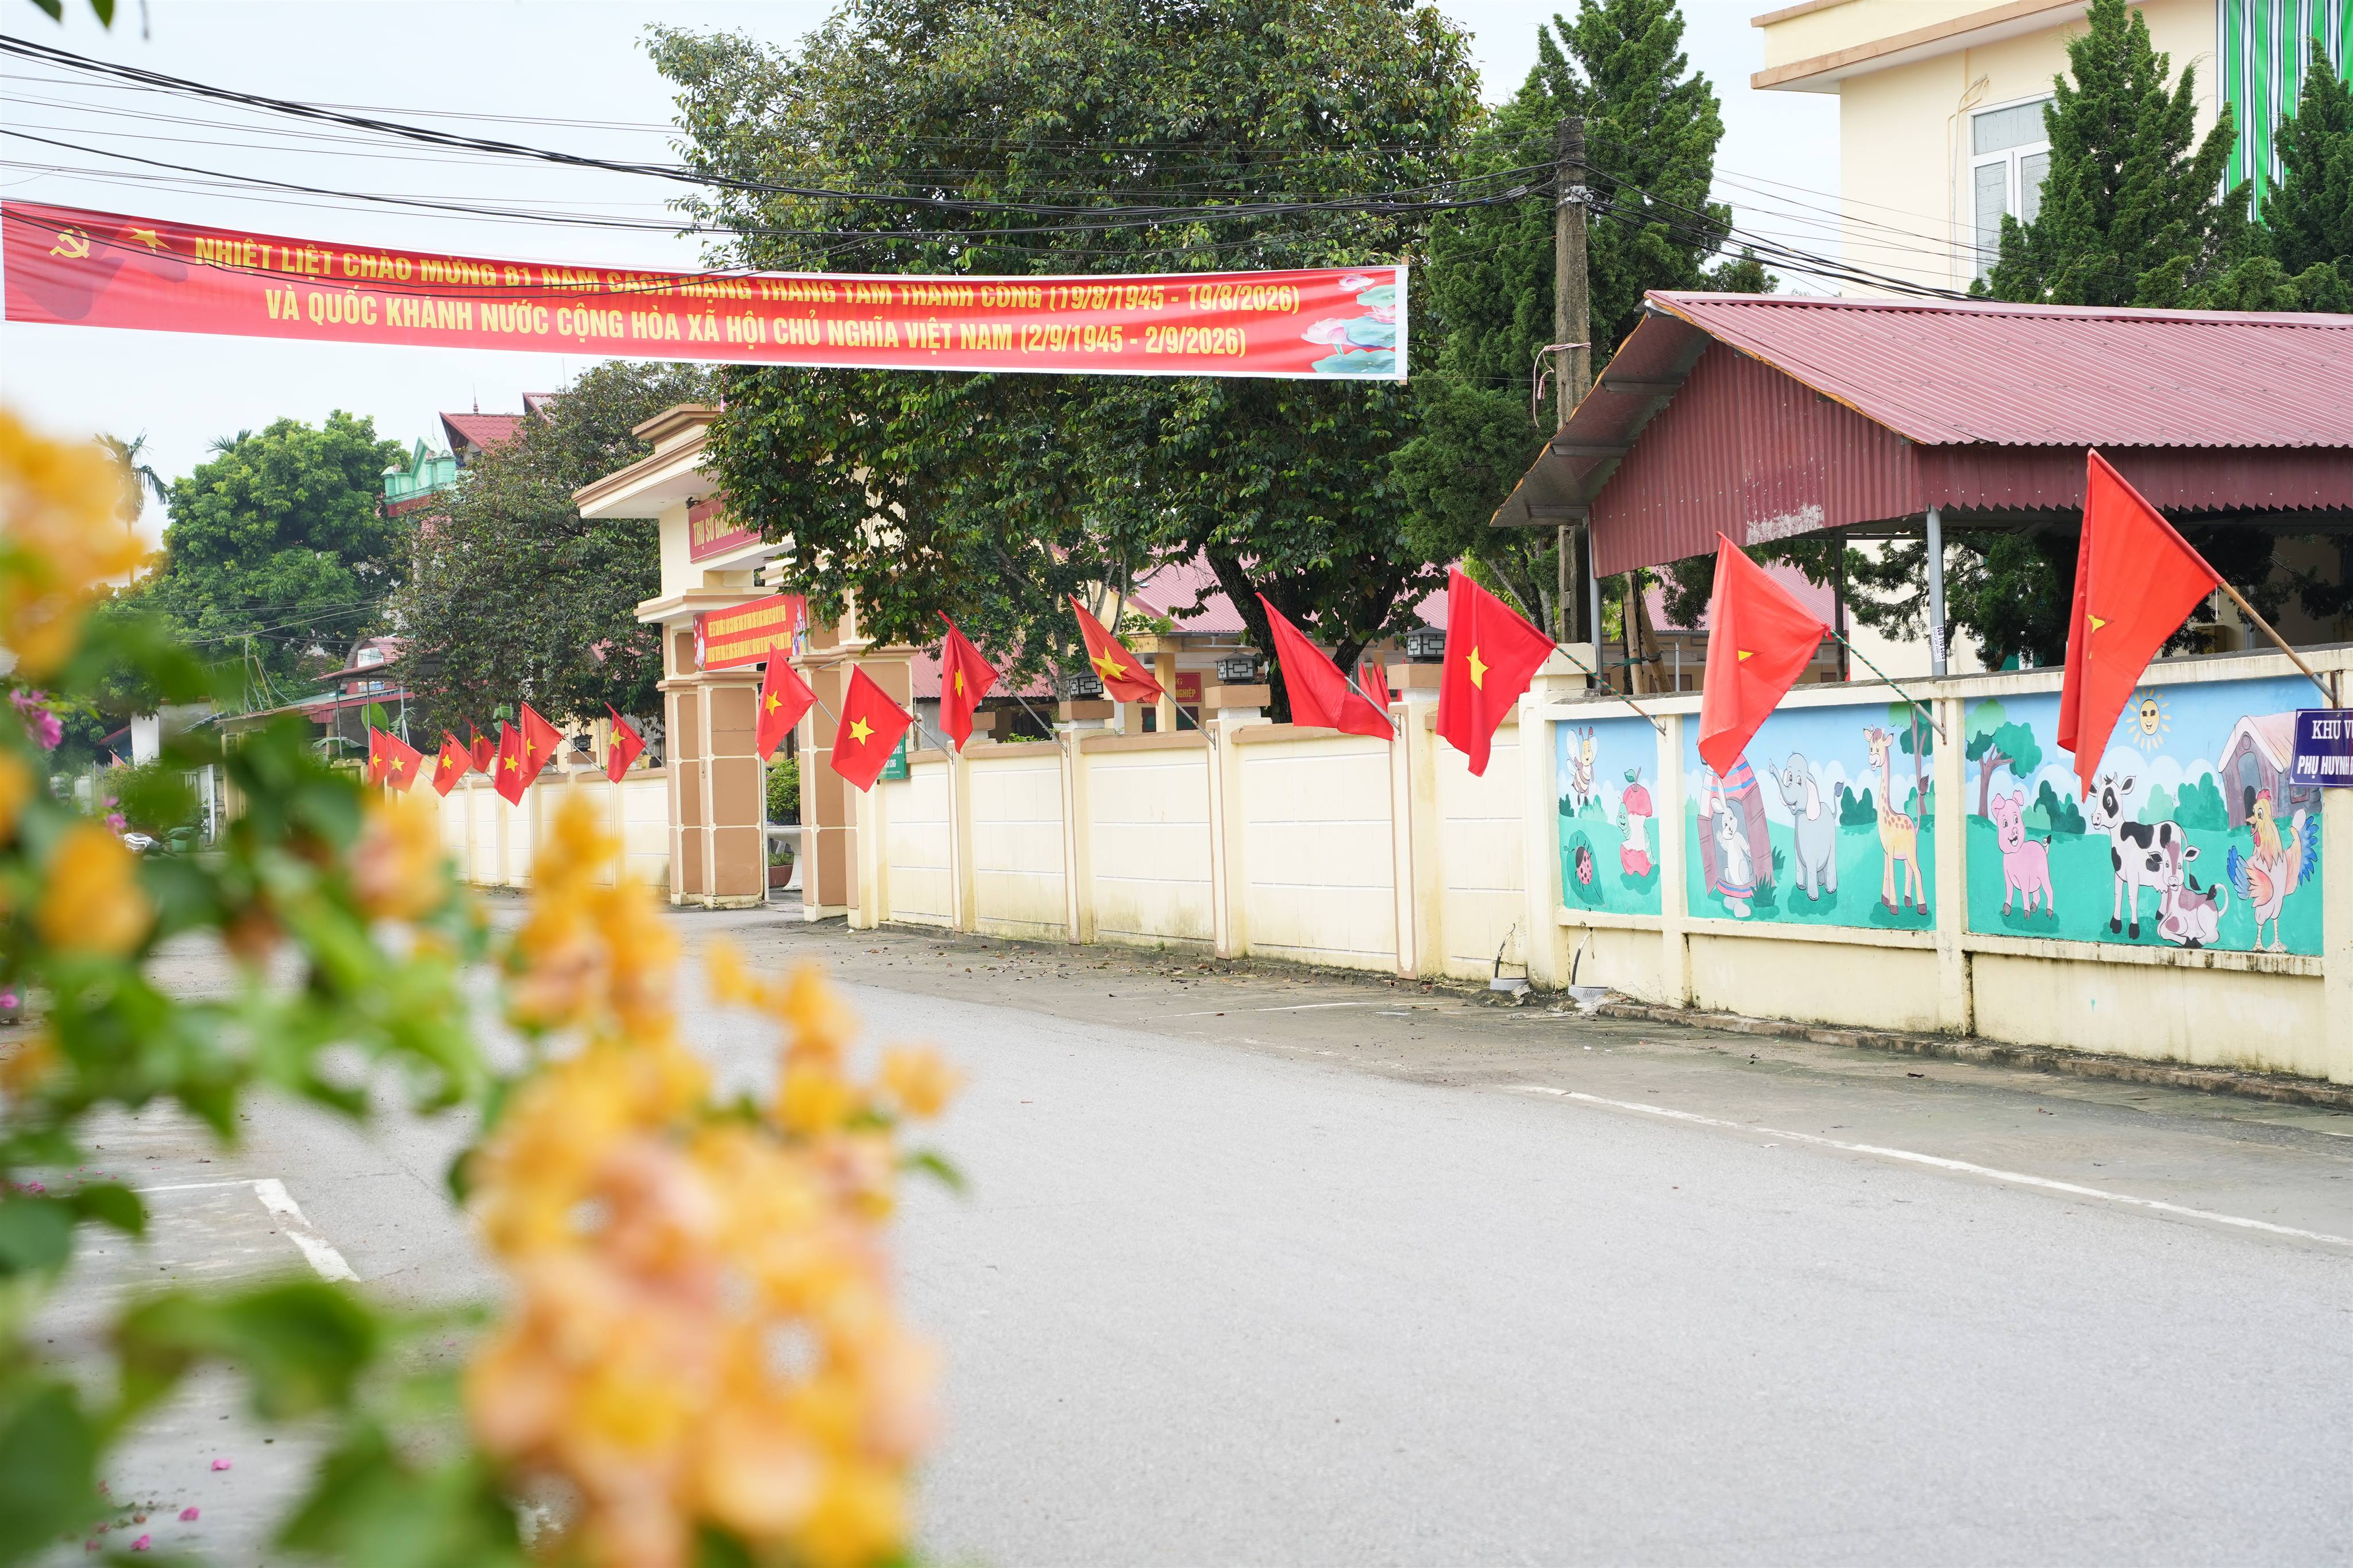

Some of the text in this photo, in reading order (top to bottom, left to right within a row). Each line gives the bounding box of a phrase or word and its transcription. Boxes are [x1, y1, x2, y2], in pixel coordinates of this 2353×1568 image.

[195, 237, 273, 276] NHIỆT
[281, 243, 334, 281] LIỆT
[343, 249, 412, 280] CHÀO
[419, 256, 497, 285] MỪNG
[504, 265, 532, 286] 81
[679, 276, 752, 304] MẠNG
[981, 281, 1042, 308] CÔNG
[1049, 285, 1165, 311] (19/8/1945
[1188, 285, 1299, 315] 19/8/2026)
[265, 284, 300, 320] VÀ
[308, 285, 377, 326] QUỐC
[385, 293, 473, 331] KHÁNH
[480, 299, 549, 335] NƯỚC
[557, 302, 624, 343] CỘNG
[631, 305, 681, 341] HÒA
[686, 309, 720, 342] XÃ
[726, 310, 766, 350] HỘI
[773, 309, 820, 346] CHỦ
[827, 315, 900, 347] NGHĨA
[904, 316, 952, 355] VIỆT
[959, 323, 1012, 350] NAM
[1021, 324, 1123, 354] (2/9/1945
[1145, 326, 1246, 358] 2/9/2026)
[693, 520, 705, 550] TRỤ
[2312, 720, 2342, 740] KHU
[2296, 755, 2319, 779] PHỤ
[2321, 755, 2350, 775] HUYNH
